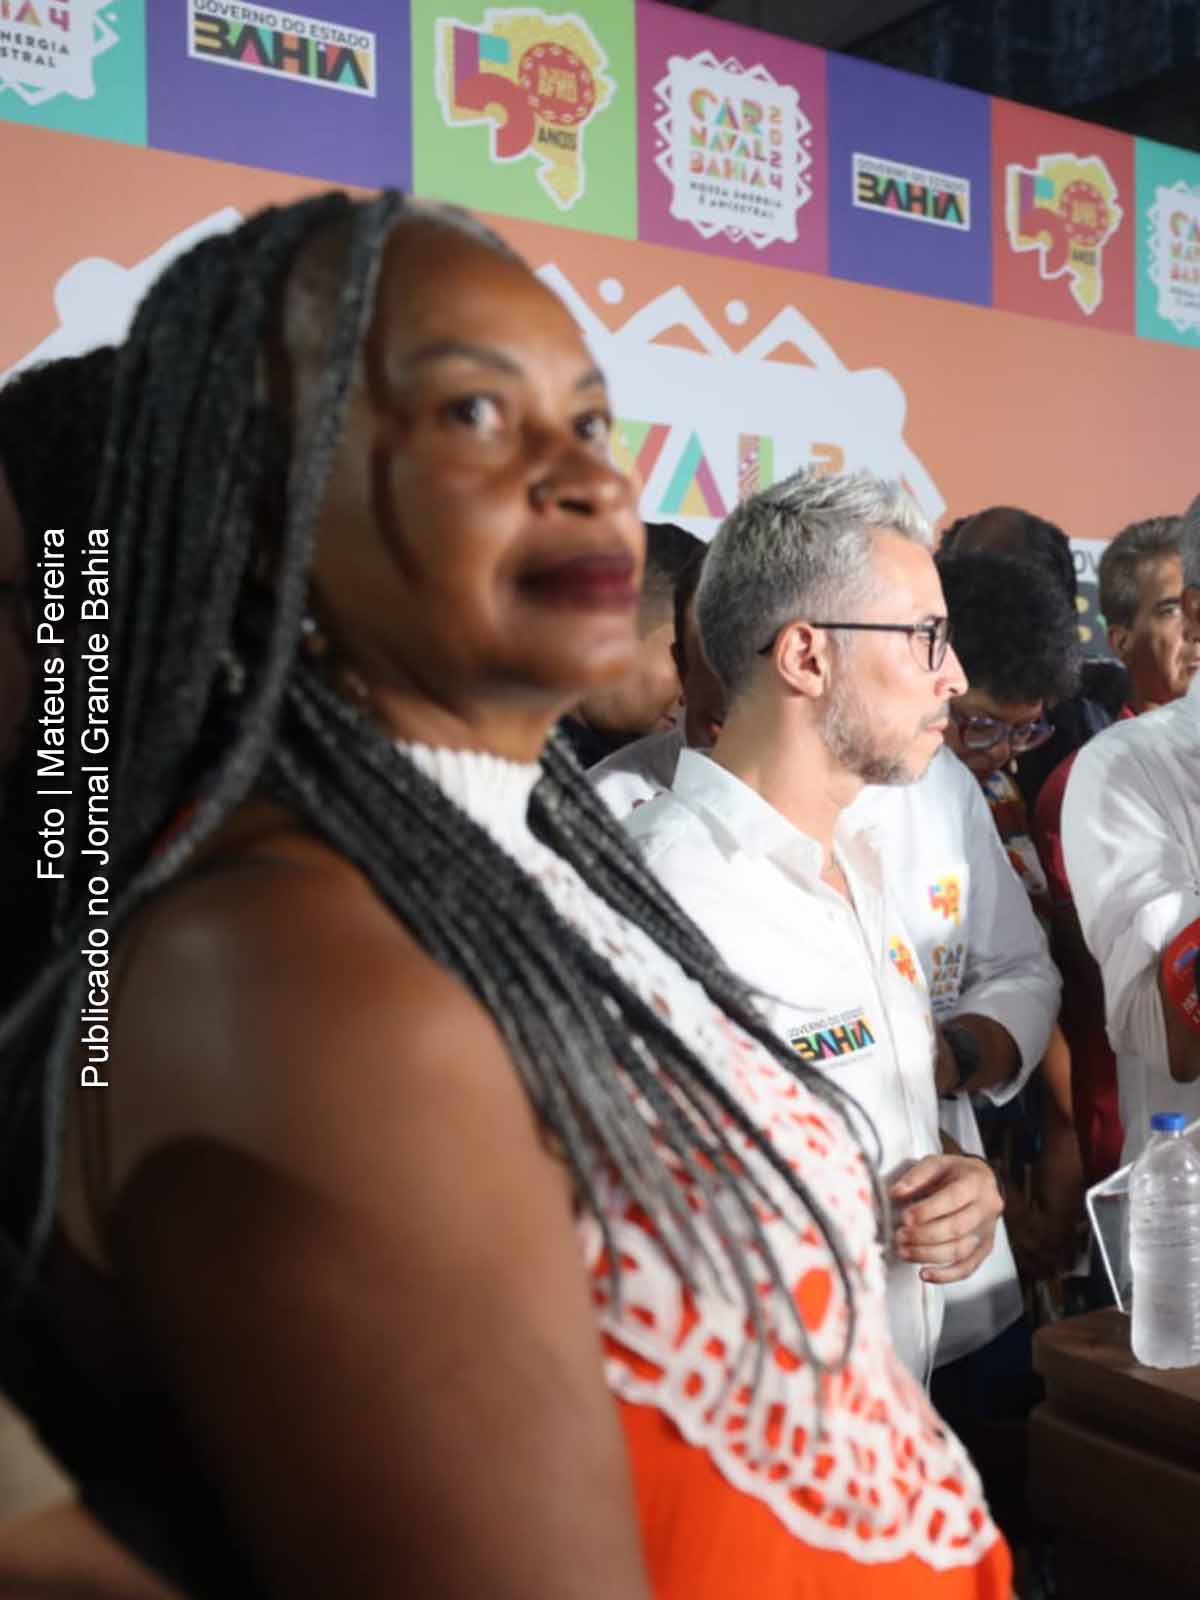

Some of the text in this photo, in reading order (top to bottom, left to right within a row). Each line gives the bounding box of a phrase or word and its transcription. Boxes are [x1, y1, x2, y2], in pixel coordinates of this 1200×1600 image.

[193, 0, 370, 50] GOVERNO DO ESTADO
[689, 87, 765, 136] CAR
[689, 125, 767, 163] NAVAL
[689, 152, 767, 189] BAHIA
